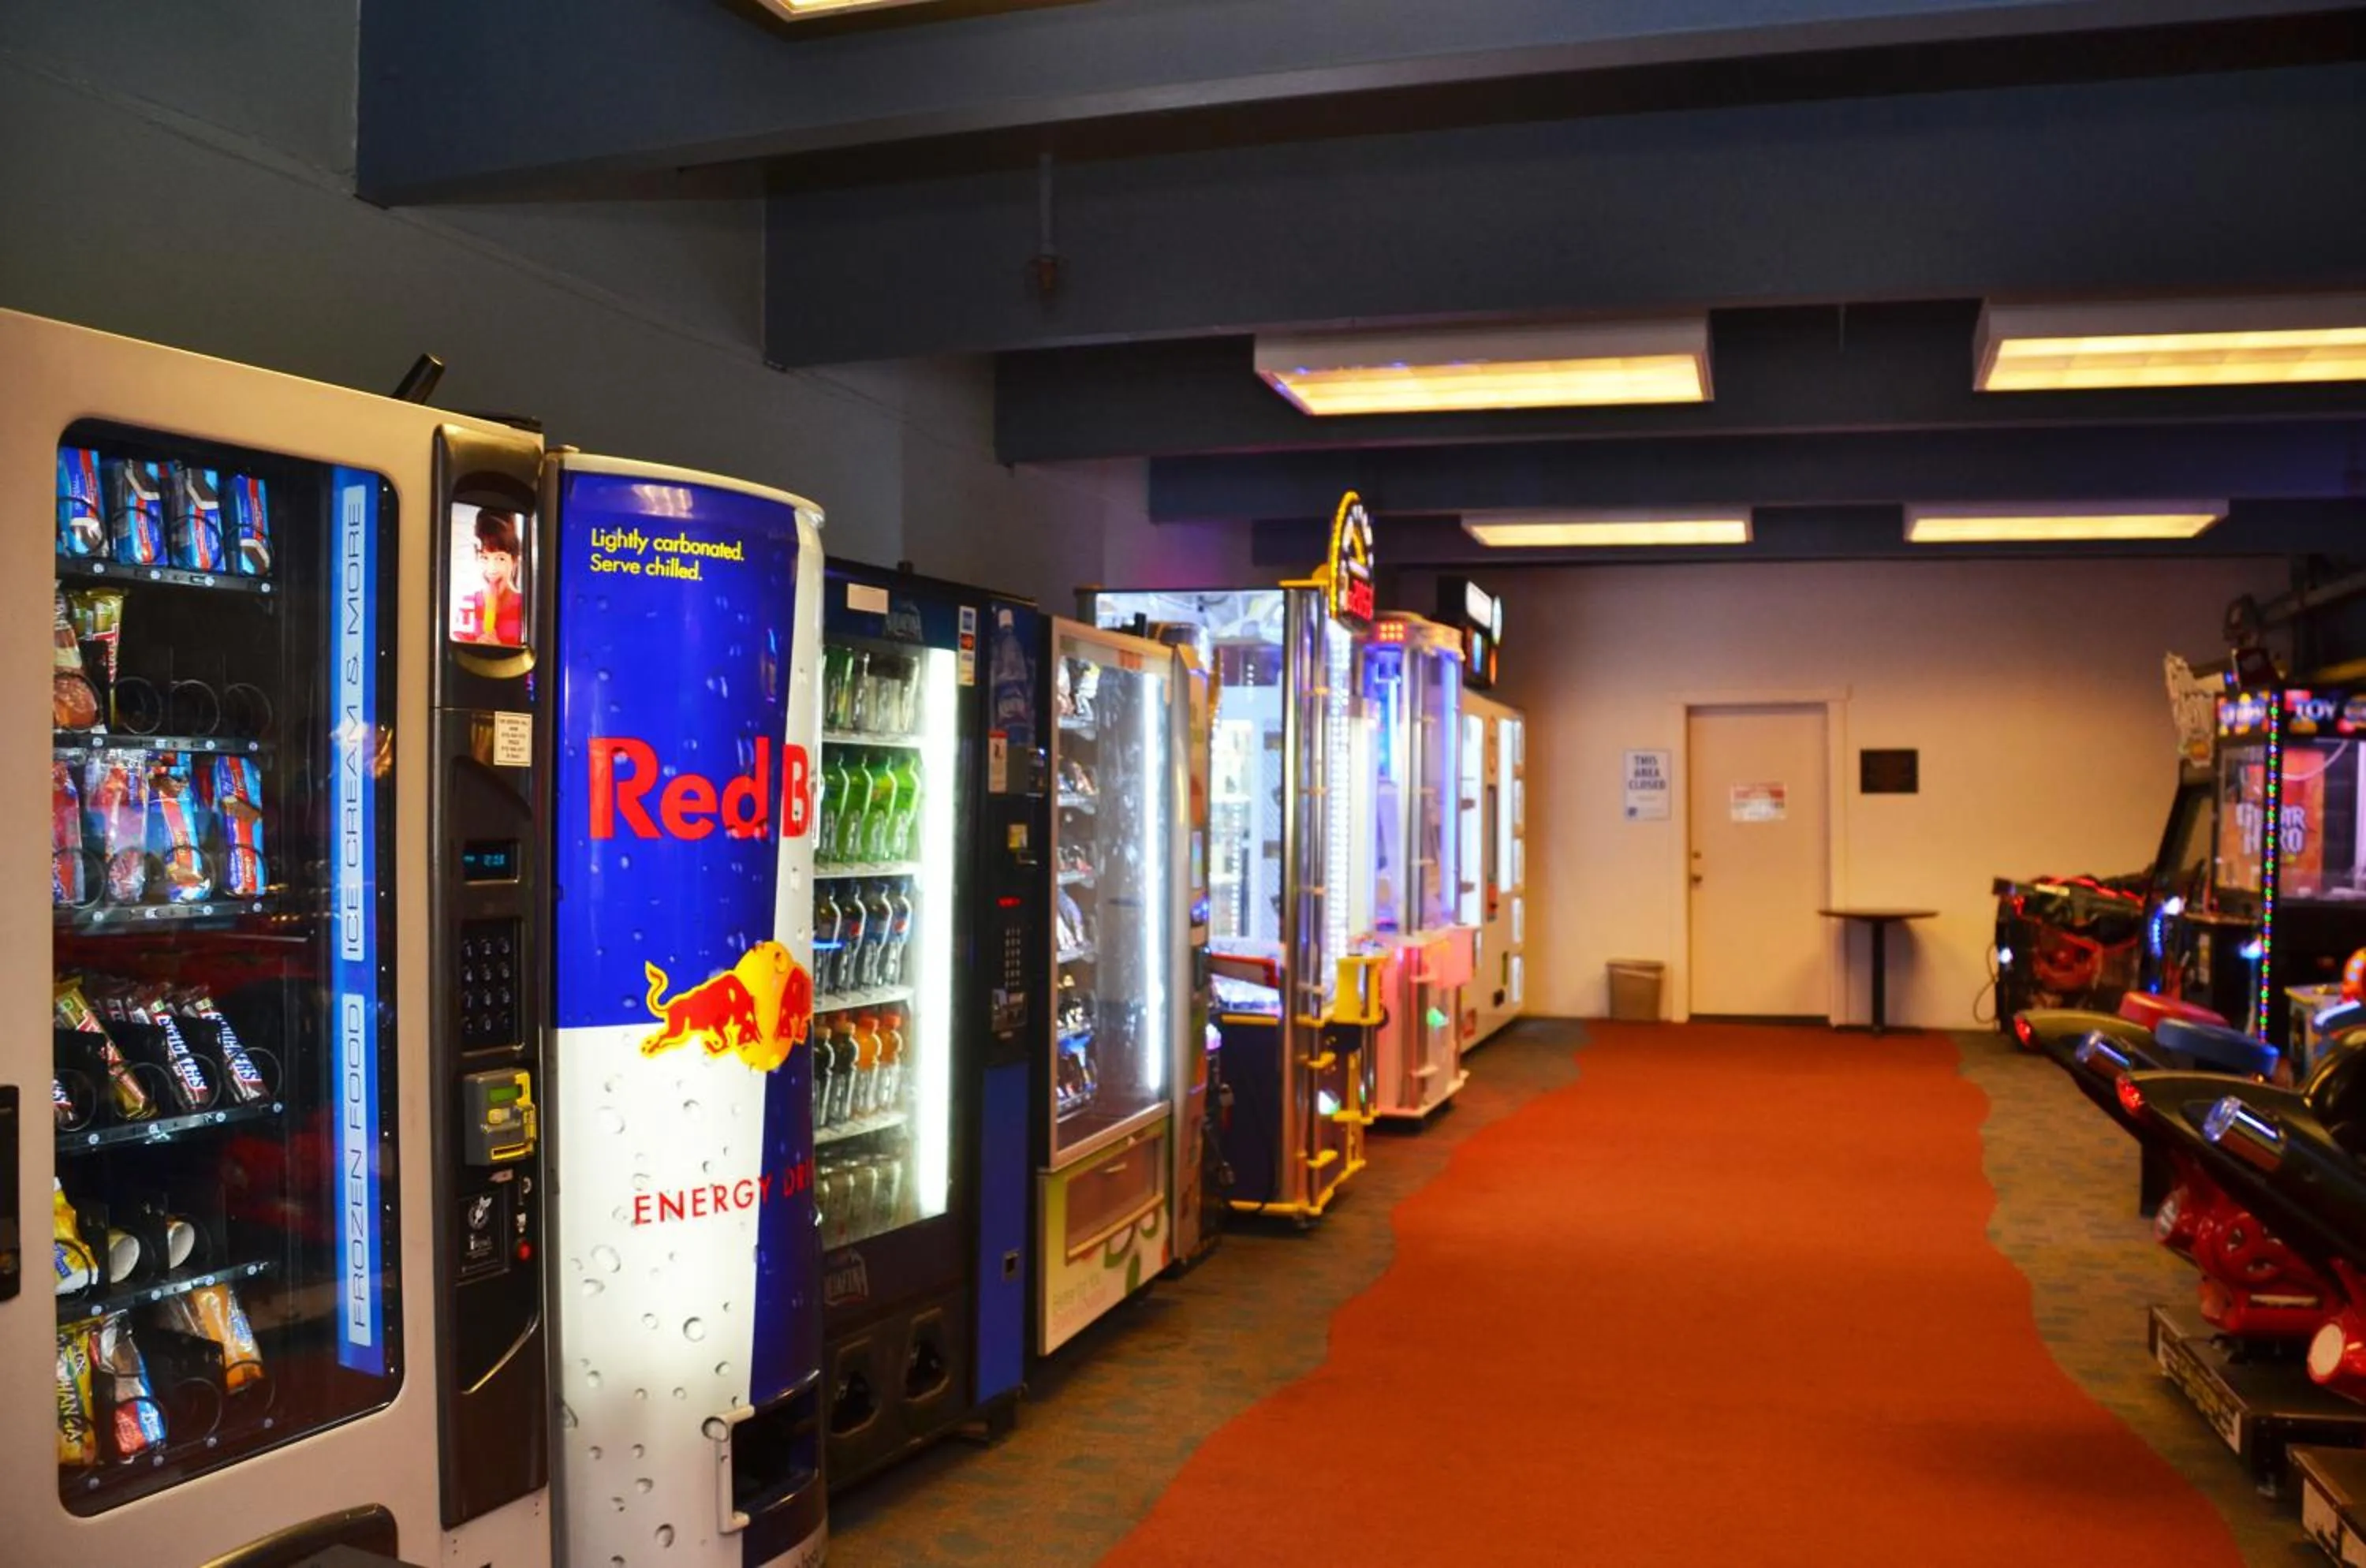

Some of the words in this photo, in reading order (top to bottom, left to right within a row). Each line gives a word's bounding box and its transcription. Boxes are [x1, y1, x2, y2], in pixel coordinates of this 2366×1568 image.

[346, 503, 360, 635] MORE
[590, 554, 641, 574] Serve
[644, 555, 703, 581] chilled.
[591, 527, 649, 555] Lightly
[652, 532, 745, 562] carbonated.
[346, 656, 360, 685] &
[345, 705, 359, 868] CREAM
[588, 735, 771, 841] Red
[346, 885, 359, 952] ICE
[347, 1003, 363, 1130] FOOD
[349, 1148, 366, 1328] FROZEN
[633, 1170, 771, 1226] ENERGY
